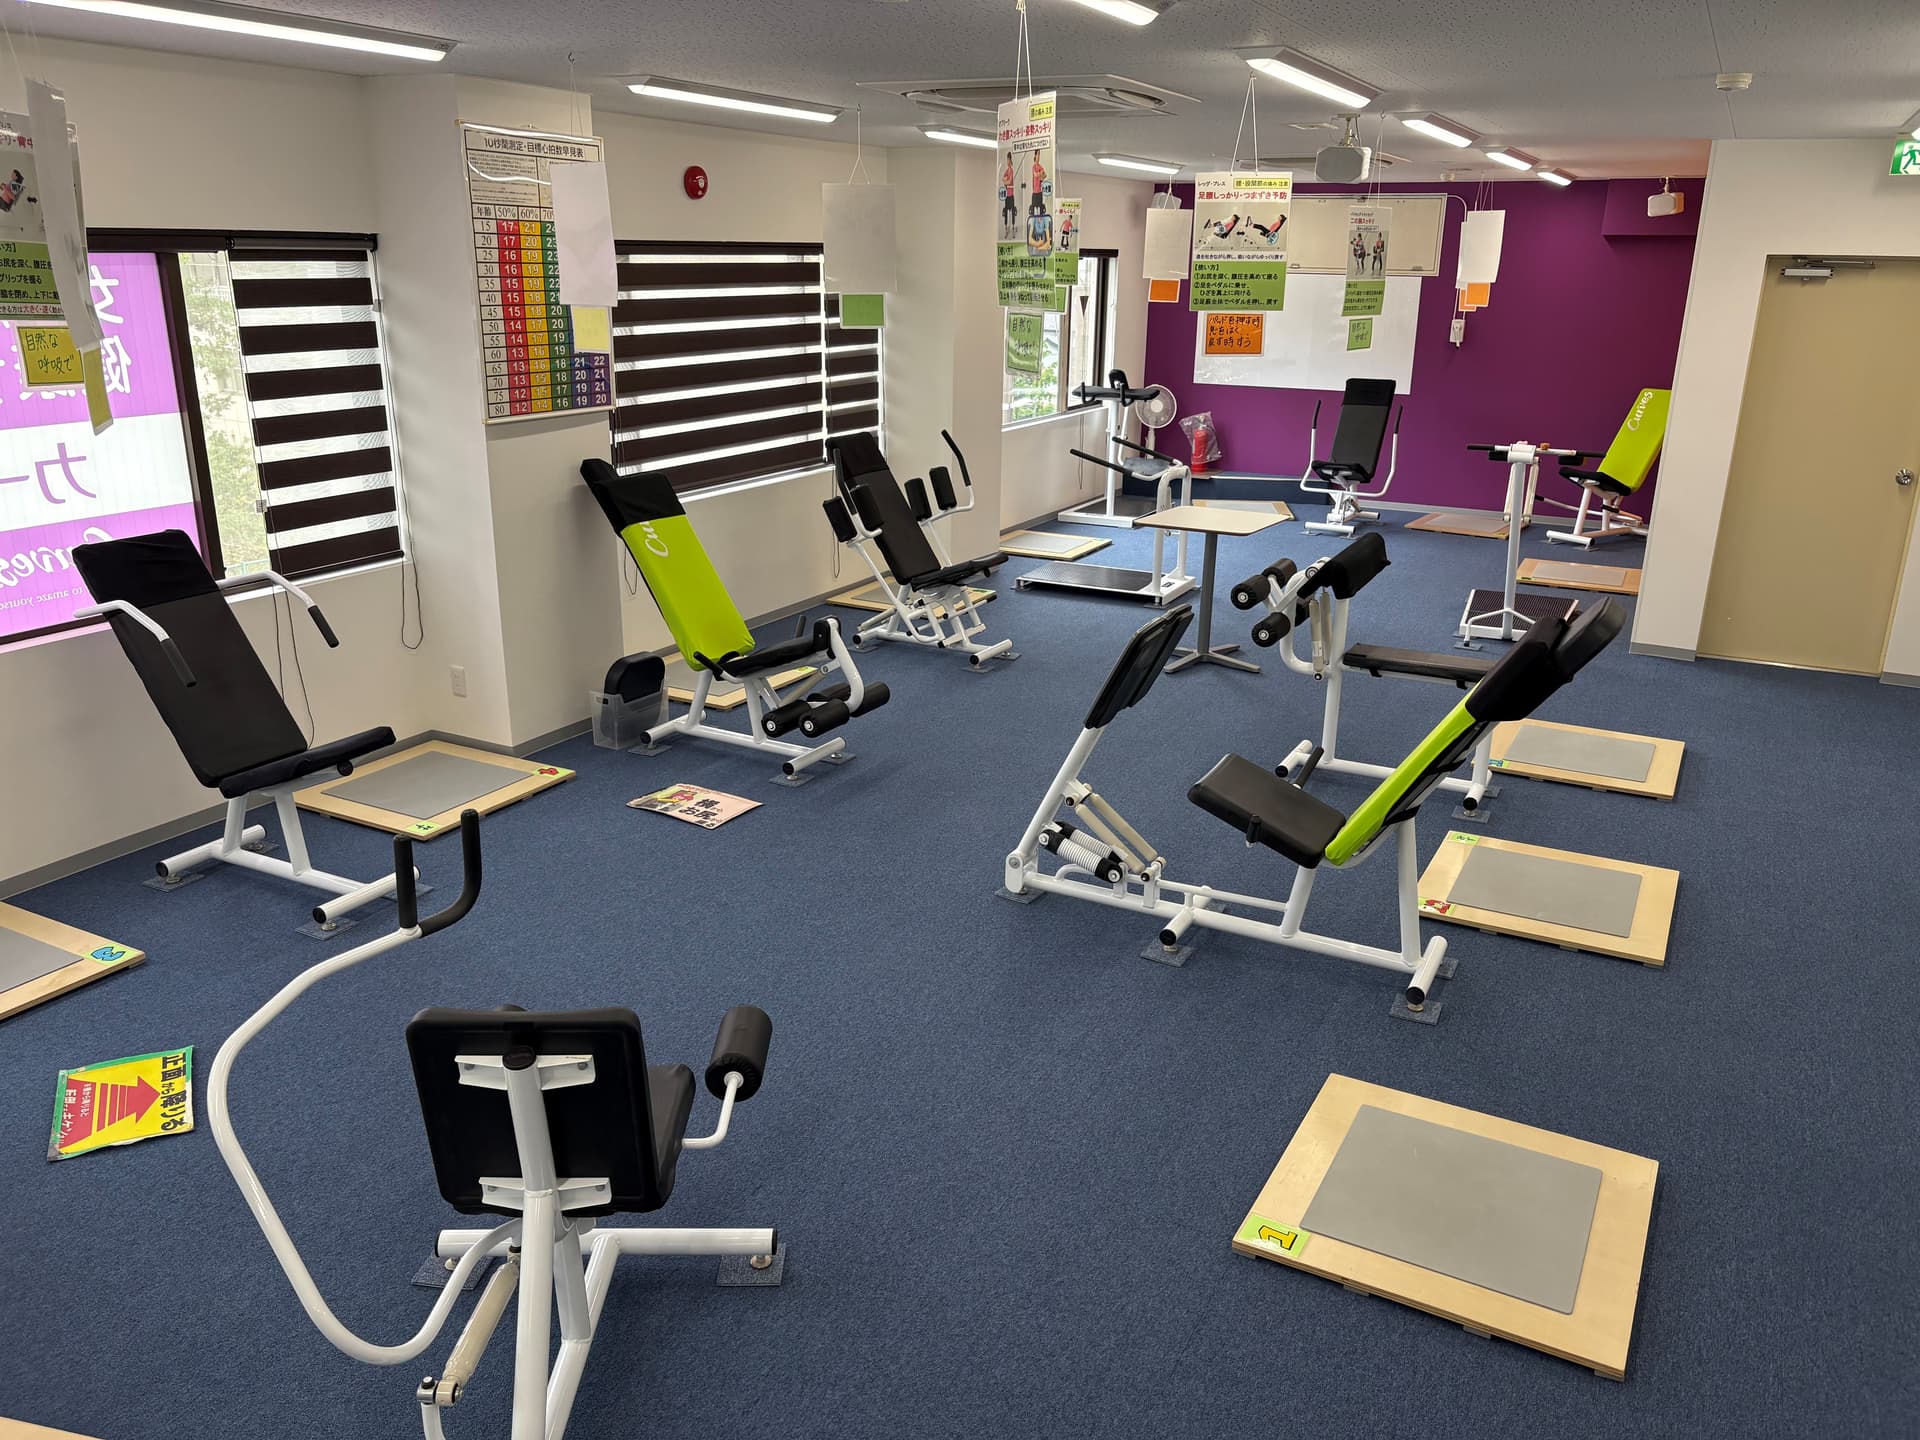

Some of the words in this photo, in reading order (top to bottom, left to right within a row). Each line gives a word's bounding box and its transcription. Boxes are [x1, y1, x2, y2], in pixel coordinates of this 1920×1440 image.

[484, 138, 584, 158] 10秒間測定・目標心拍数早見表
[1198, 191, 1288, 200] 足腰しっかり・つまずき予防
[497, 207, 516, 218] 50%
[521, 208, 538, 220] 60%
[542, 209, 554, 220] 70
[481, 221, 490, 231] 15
[502, 221, 514, 232] 17
[525, 222, 536, 233] 21
[481, 236, 492, 246] 20
[504, 236, 515, 246] 17
[526, 237, 537, 247] 20
[483, 250, 493, 261] 25
[504, 250, 517, 260] 16
[527, 251, 538, 261] 19
[484, 264, 494, 274] 30
[505, 265, 517, 275] 16
[528, 265, 539, 274] 19
[548, 265, 560, 275] 22
[1194, 263, 1220, 272] 【使い方】
[485, 279, 495, 289] 35
[506, 279, 518, 289] 15
[549, 279, 560, 288] 22
[486, 293, 496, 304] 40
[507, 293, 520, 303] 15
[488, 307, 498, 317] 45
[508, 306, 521, 316] 15
[551, 306, 563, 316] 20
[489, 322, 499, 332] 50
[510, 320, 522, 330] 14
[552, 319, 564, 329] 20
[25, 330, 58, 351] 自然な
[490, 335, 500, 346] 55
[511, 334, 523, 344] 14
[553, 332, 565, 343] 19
[491, 349, 501, 359] 60
[512, 348, 524, 358] 13
[554, 345, 565, 355] 19
[37, 354, 74, 375] 呼吸で
[492, 363, 502, 374] 65
[513, 362, 525, 372] 13
[556, 359, 566, 369] 18
[574, 357, 585, 367] 21
[594, 356, 605, 366] 22
[493, 377, 503, 388] 70
[514, 375, 526, 385] 13
[556, 372, 567, 381] 18
[575, 370, 587, 380] 20
[595, 369, 605, 379] 21
[494, 391, 504, 402] 75
[515, 389, 527, 399] 12
[557, 385, 567, 395] 17
[576, 383, 587, 393] 19
[595, 381, 605, 391] 21
[495, 405, 504, 415] 80
[515, 402, 527, 412] 12
[557, 397, 569, 408] 16
[577, 396, 588, 406] 19
[596, 394, 607, 404] 20
[1627, 391, 1653, 431] Curves
[160, 1052, 187, 1131] 正面から降りる
[1258, 1225, 1298, 1251] 1
